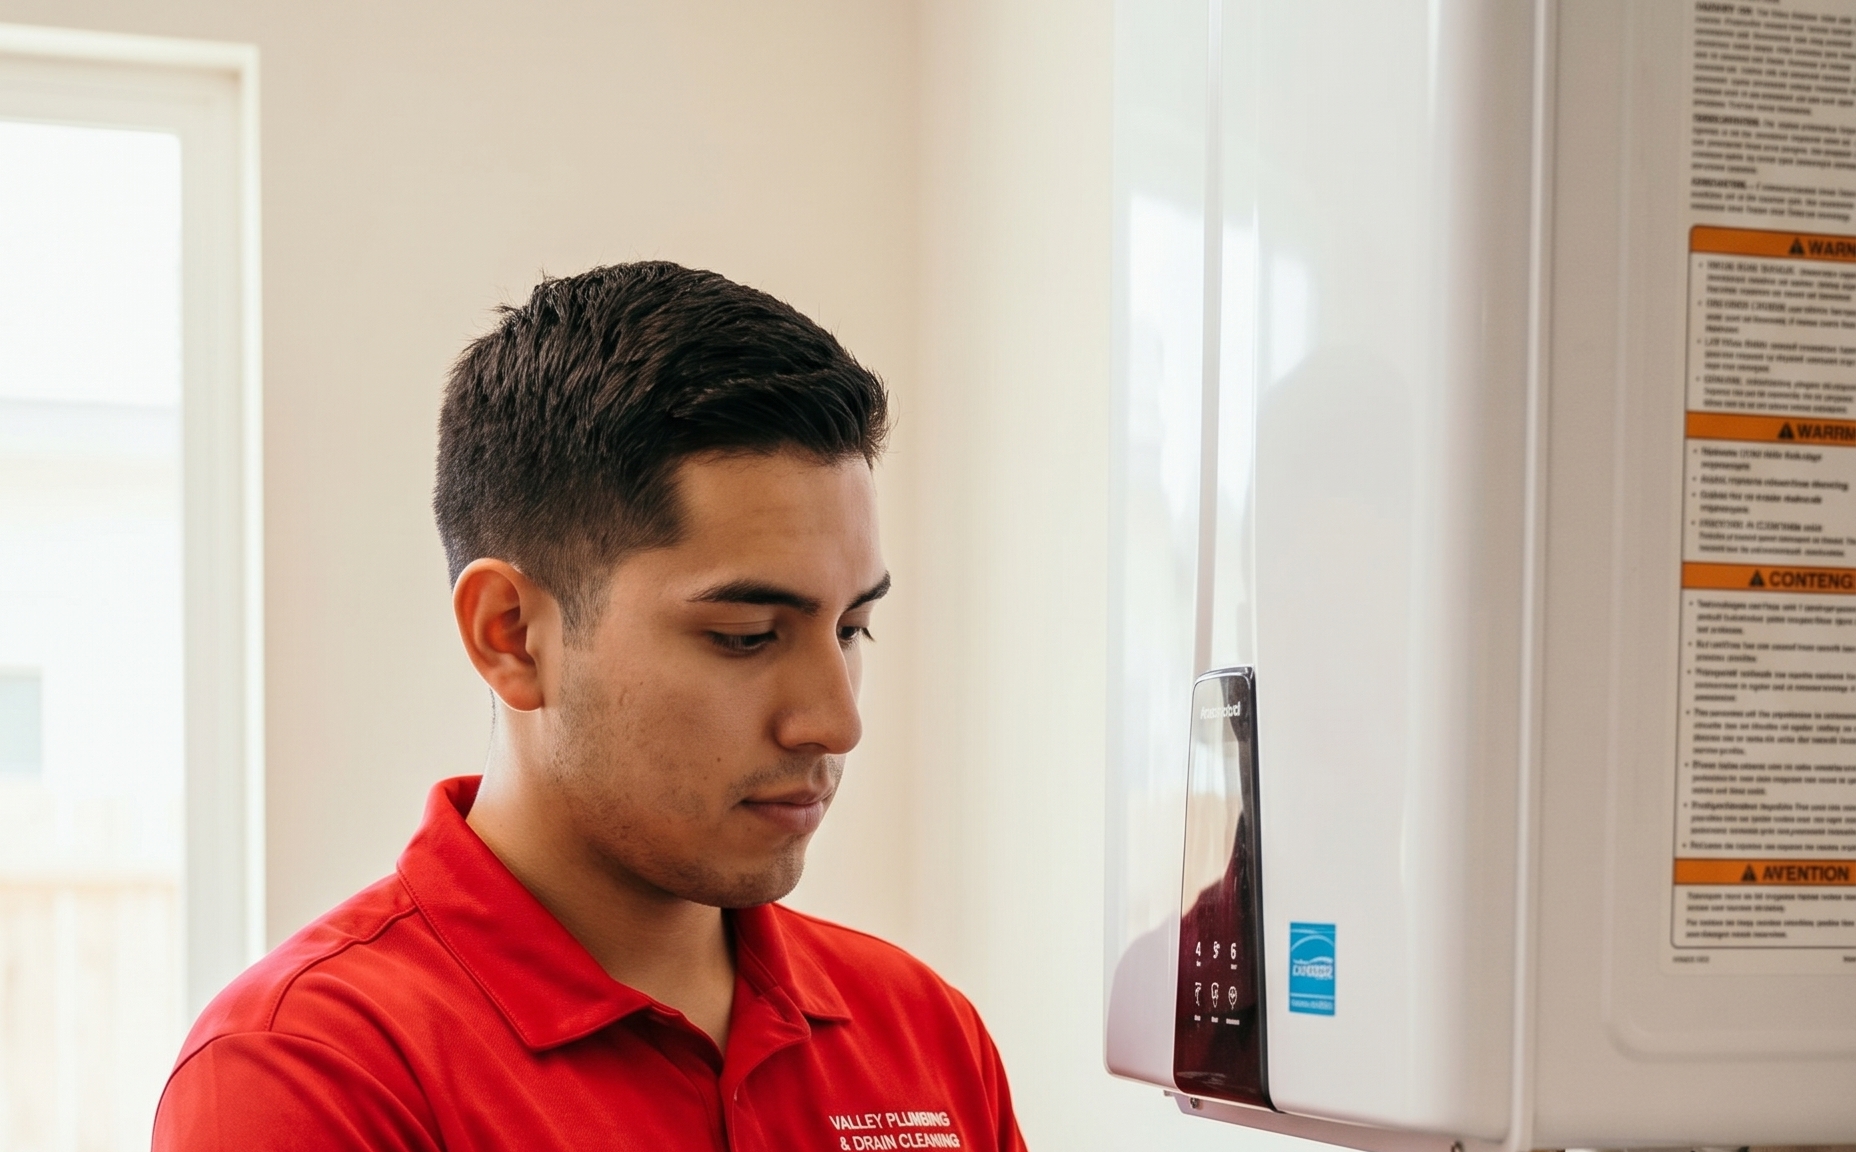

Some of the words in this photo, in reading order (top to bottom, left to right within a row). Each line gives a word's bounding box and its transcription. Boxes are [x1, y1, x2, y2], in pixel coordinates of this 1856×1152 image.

[1768, 570, 1854, 590] CONTENG
[1762, 864, 1850, 882] AVENTION
[1195, 941, 1202, 957] 4
[1230, 942, 1237, 960] 6
[829, 1113, 883, 1130] VALLEY
[885, 1111, 951, 1129] PLUMBING
[840, 1136, 851, 1151] &
[852, 1134, 898, 1151] DRAIN
[898, 1133, 961, 1148] CLEANING
